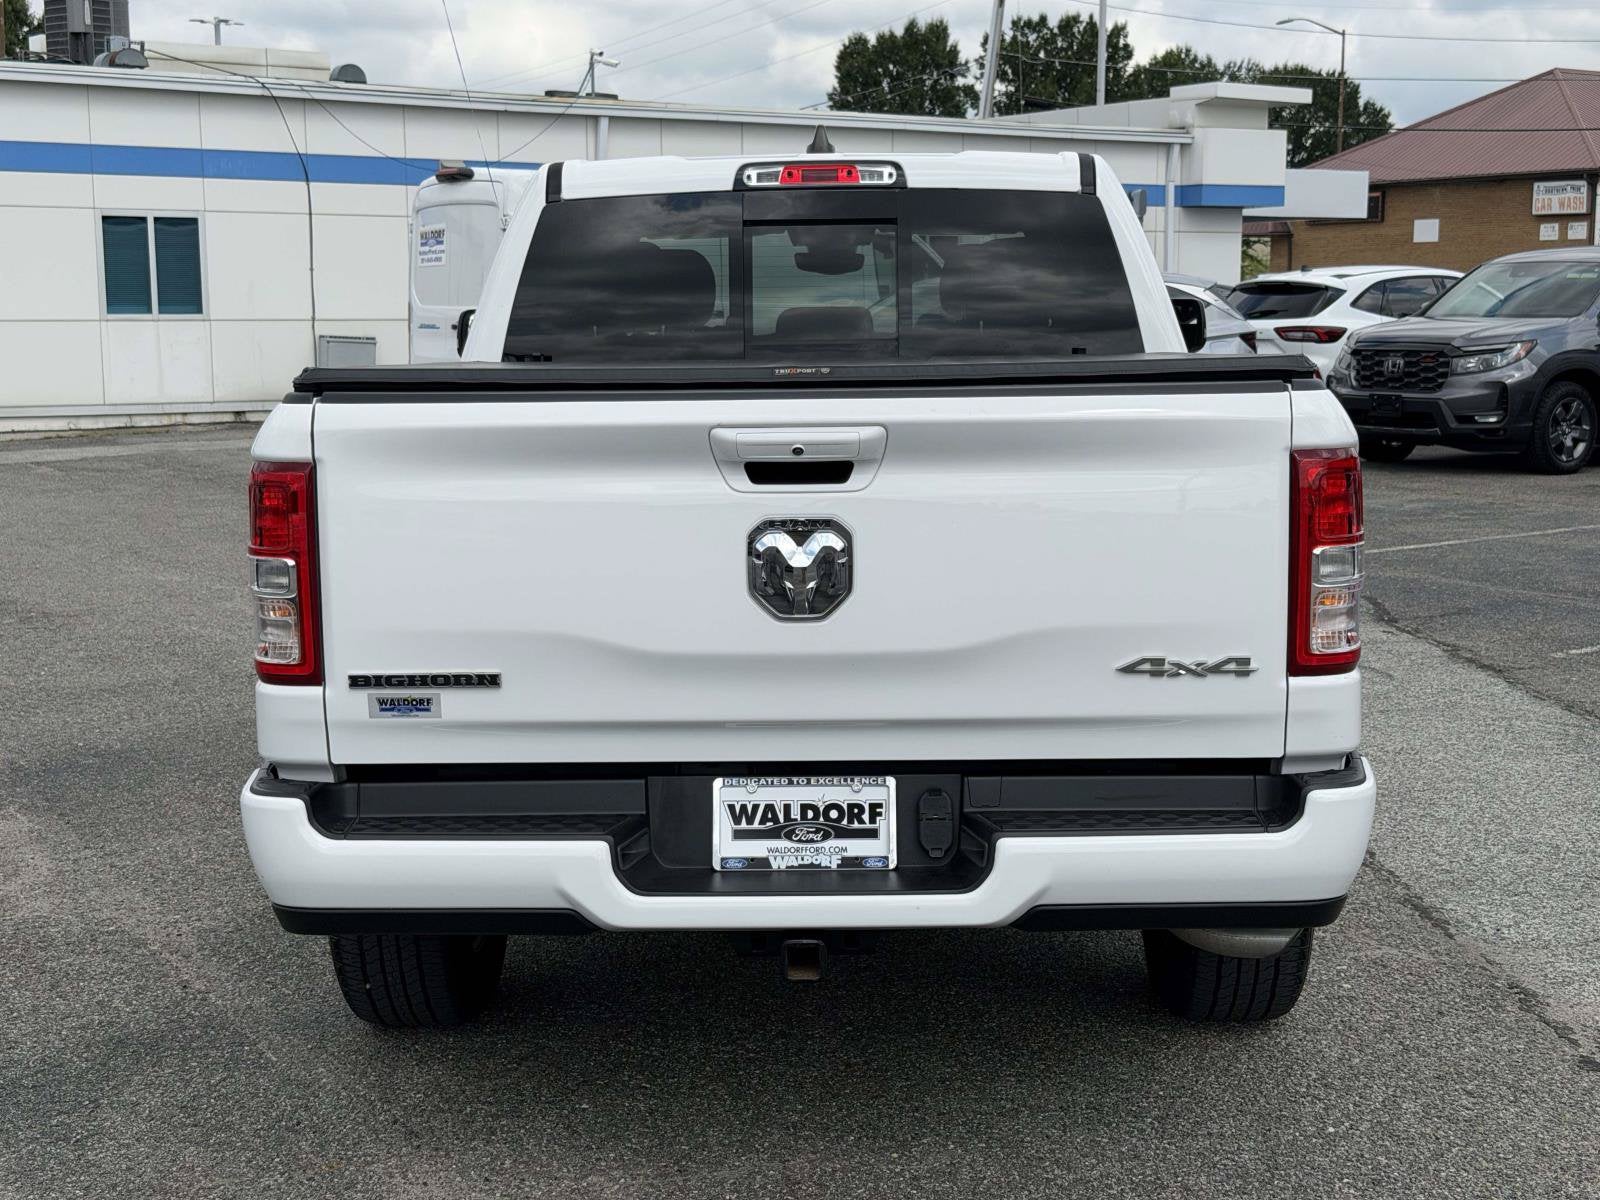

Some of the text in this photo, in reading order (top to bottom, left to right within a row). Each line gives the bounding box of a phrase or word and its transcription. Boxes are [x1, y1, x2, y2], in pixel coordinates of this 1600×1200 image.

[1535, 195, 1584, 212] CAR WASH
[348, 673, 502, 688] BIGHORN
[377, 697, 433, 707] WALDORF
[724, 778, 787, 786] DEDICATED
[811, 777, 886, 785] EXCELLENCE
[725, 800, 886, 827] WALDORF
[792, 827, 824, 842] Ford
[767, 846, 848, 854] WALDORFFORD.COM
[726, 858, 746, 867] Ford
[768, 855, 842, 869] WALDORF
[866, 857, 886, 867] Ford
